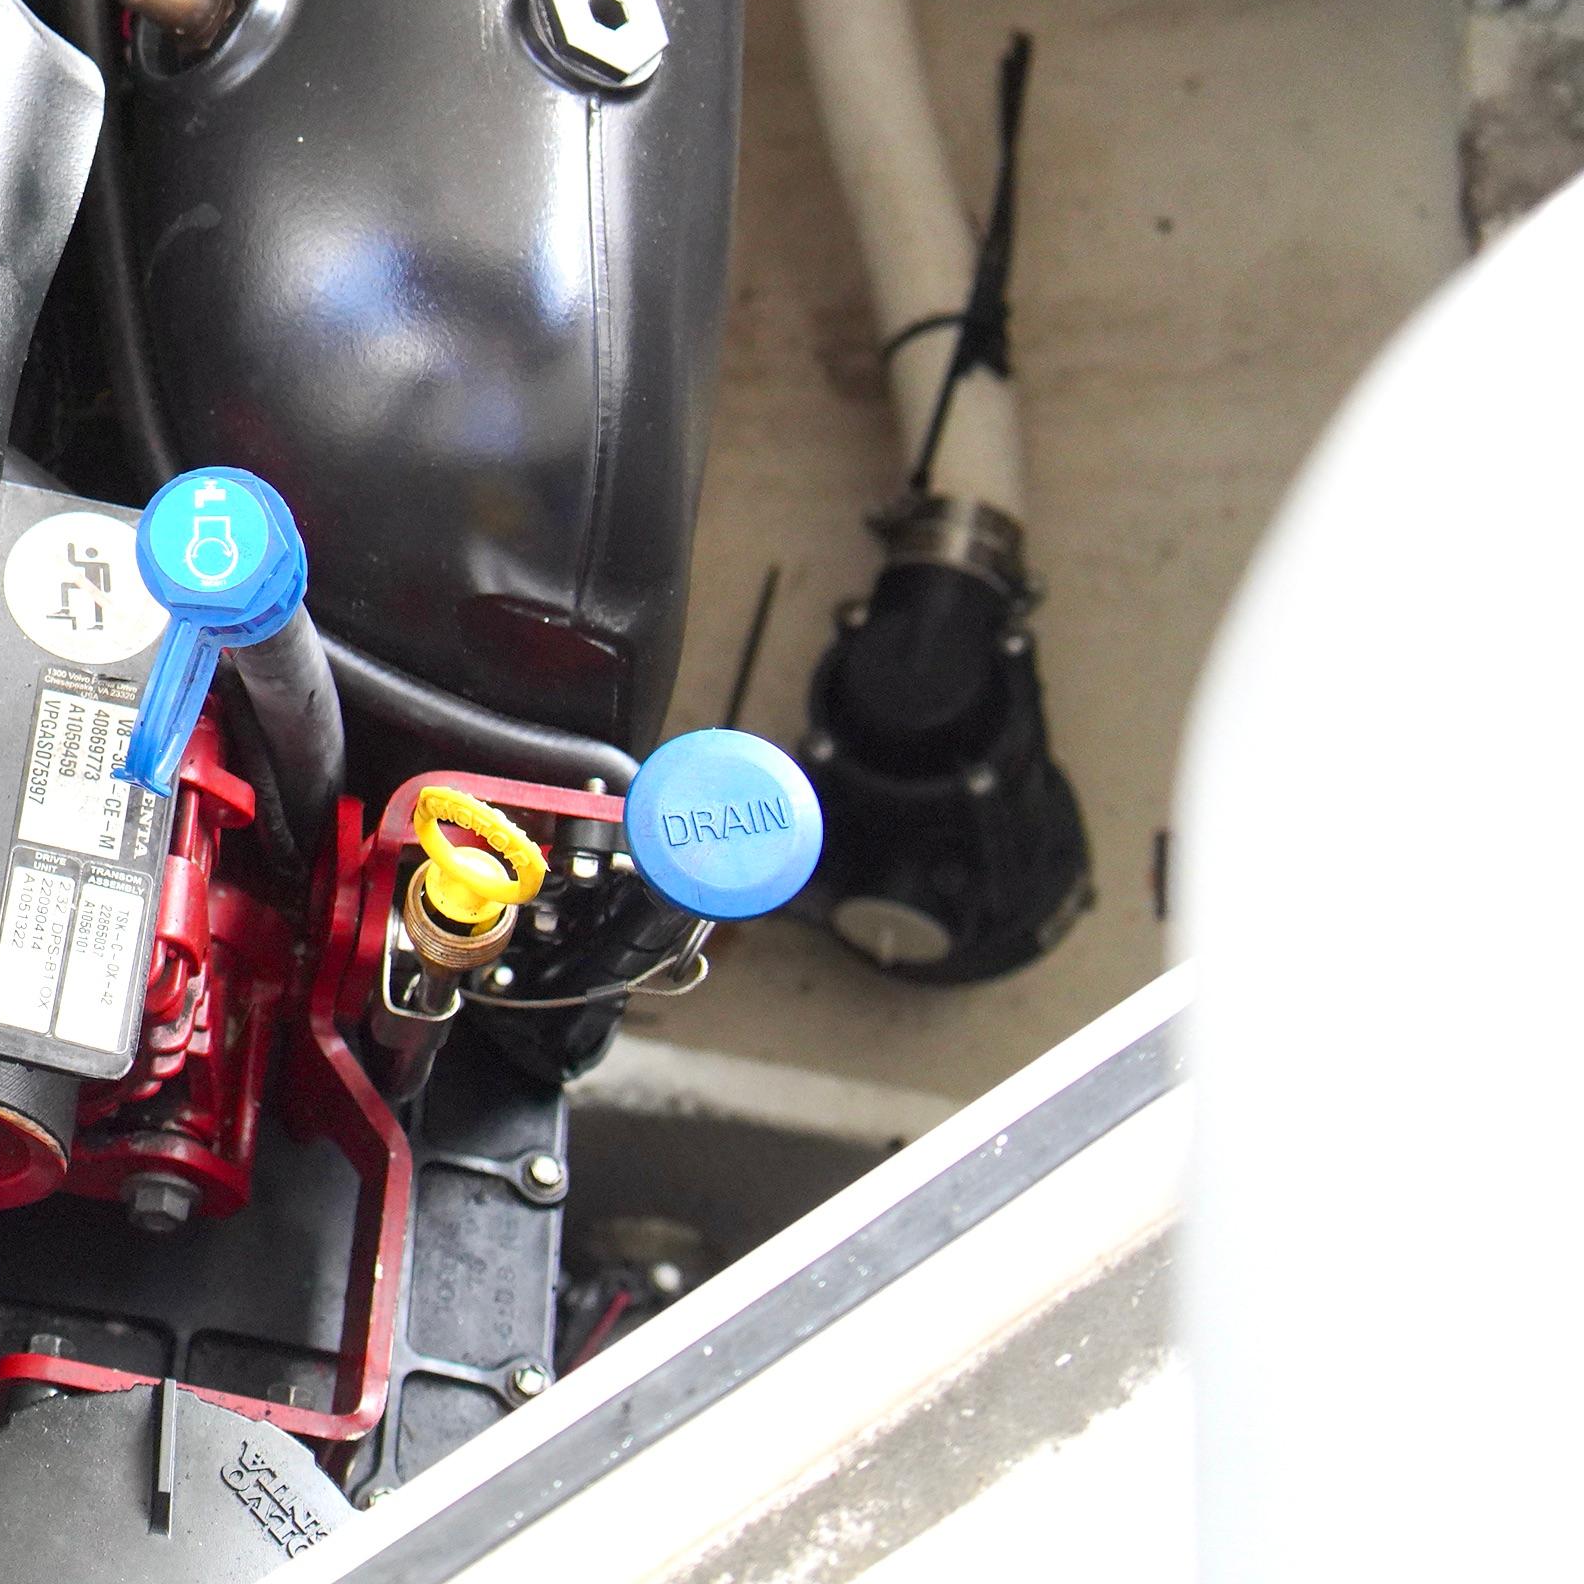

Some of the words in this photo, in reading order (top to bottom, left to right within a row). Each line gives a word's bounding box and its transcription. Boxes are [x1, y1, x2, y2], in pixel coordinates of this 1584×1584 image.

[47, 667, 68, 679] 1300
[97, 686, 109, 696] VA
[29, 700, 61, 806] VPGAS075397
[58, 703, 86, 777] A1059459
[83, 709, 111, 782] 40869773
[133, 791, 158, 860] ENTA
[662, 796, 790, 848] DRAIN
[33, 861, 58, 874] UNIT
[35, 852, 68, 866] DRIVE
[90, 865, 143, 886] TRANSOM
[11, 872, 35, 950] A1051322
[88, 875, 145, 896] ASSEMBLY
[30, 878, 55, 951] 22090414
